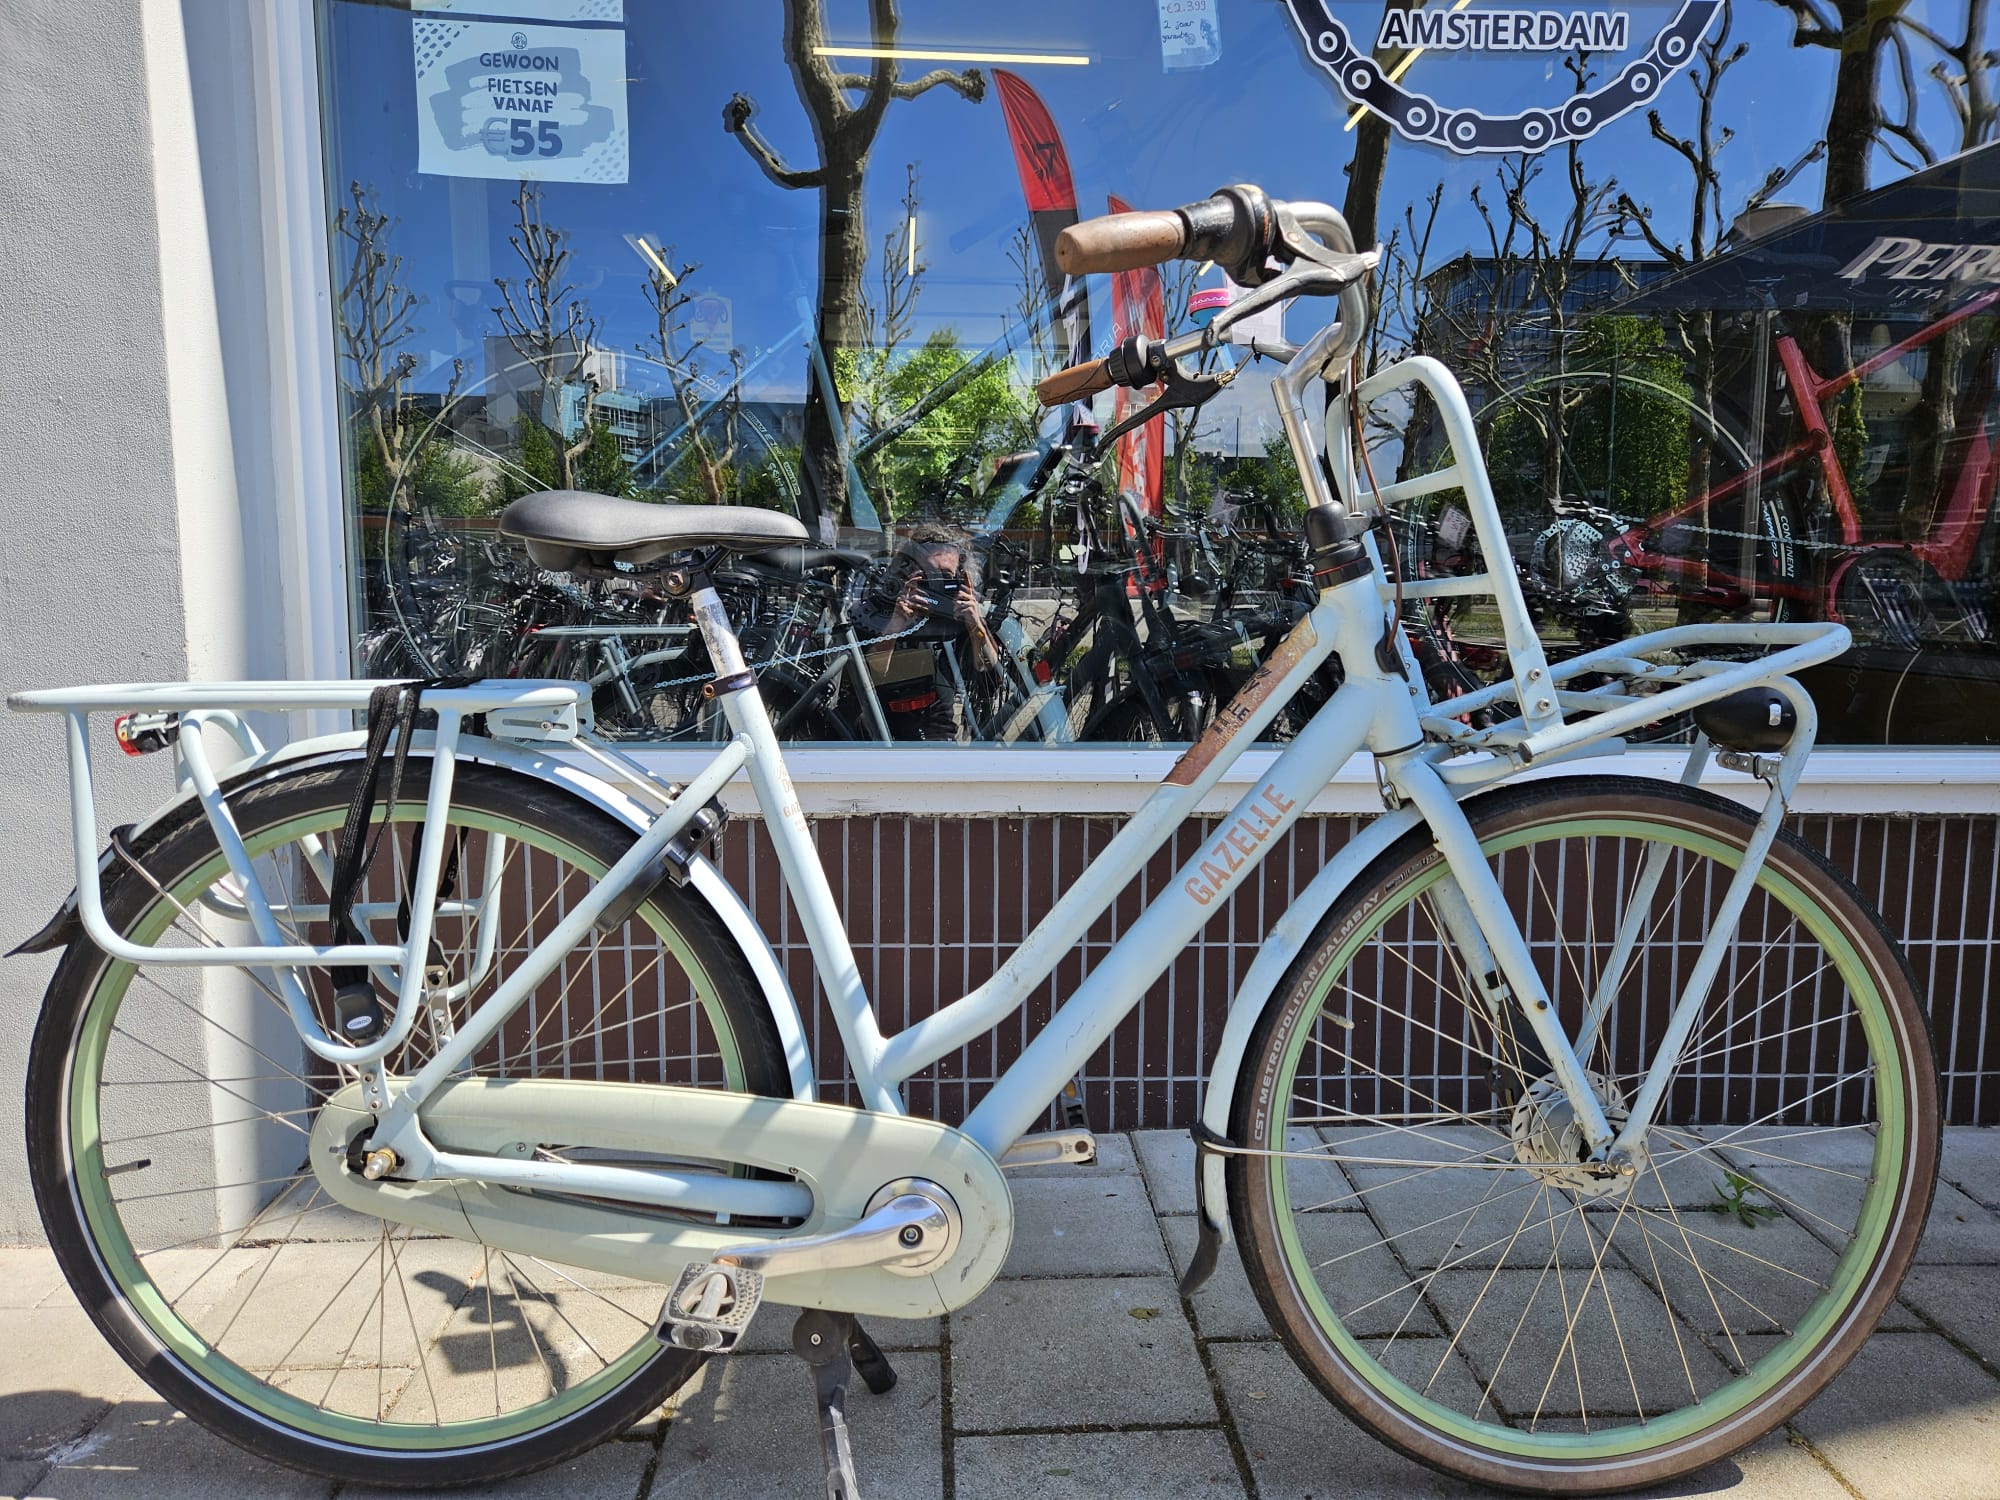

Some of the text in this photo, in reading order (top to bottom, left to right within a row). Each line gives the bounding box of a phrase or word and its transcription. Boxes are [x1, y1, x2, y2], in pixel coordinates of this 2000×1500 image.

[1380, 11, 1627, 48] AMSTERDAM
[479, 52, 559, 71] GEWOON
[488, 78, 558, 96] FIETSEN
[493, 96, 553, 113] VANAF
[480, 117, 563, 157] €55
[1184, 783, 1296, 906] GAZELLE
[1254, 892, 1379, 1142] CST METROPOLITAN PALMBAY
